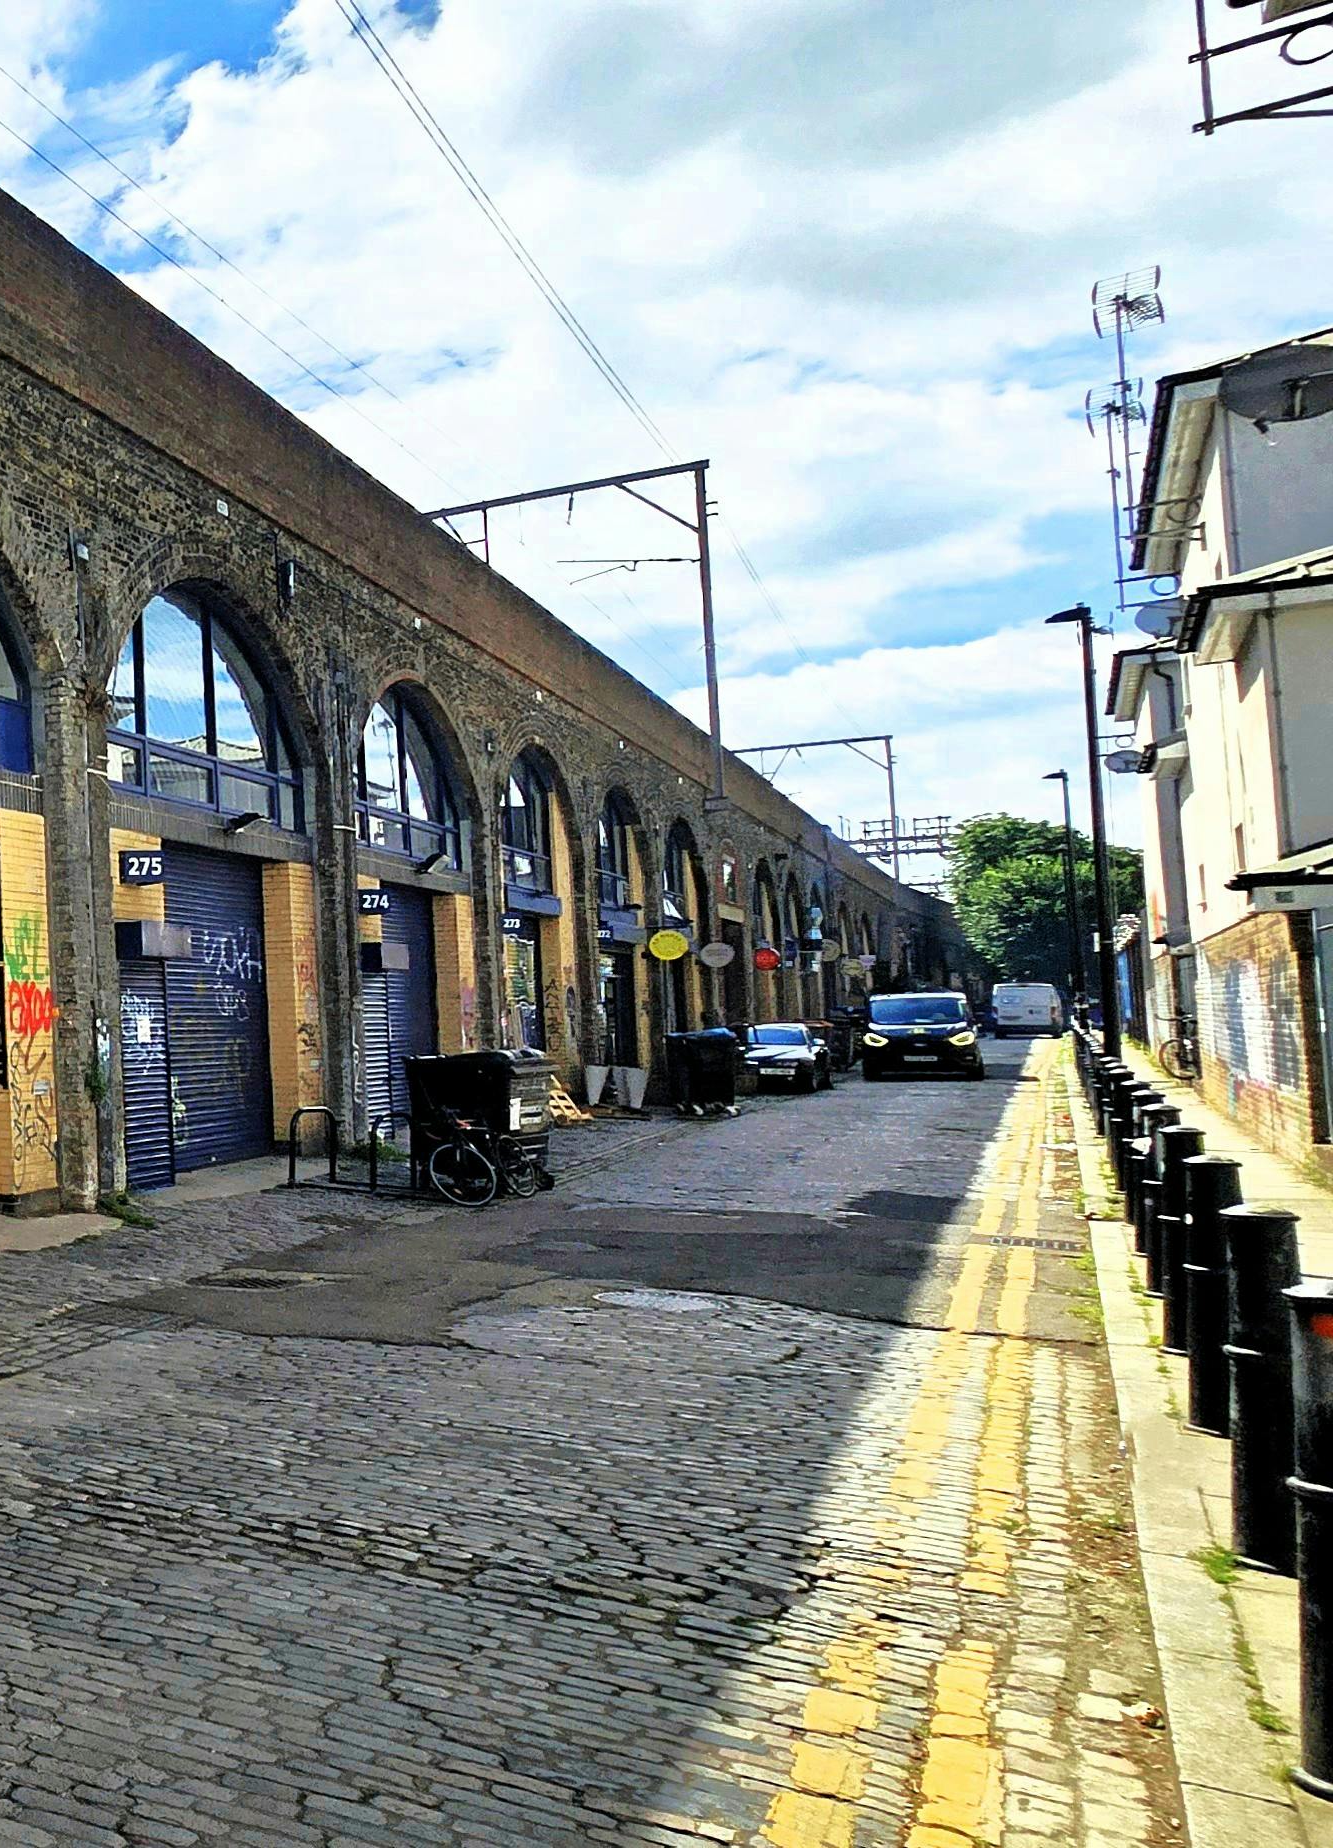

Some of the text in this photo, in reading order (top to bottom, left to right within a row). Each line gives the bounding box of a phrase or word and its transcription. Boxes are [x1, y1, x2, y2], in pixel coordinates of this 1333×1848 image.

[128, 857, 162, 876] 275
[362, 894, 390, 909] 274
[502, 918, 521, 929] 273
